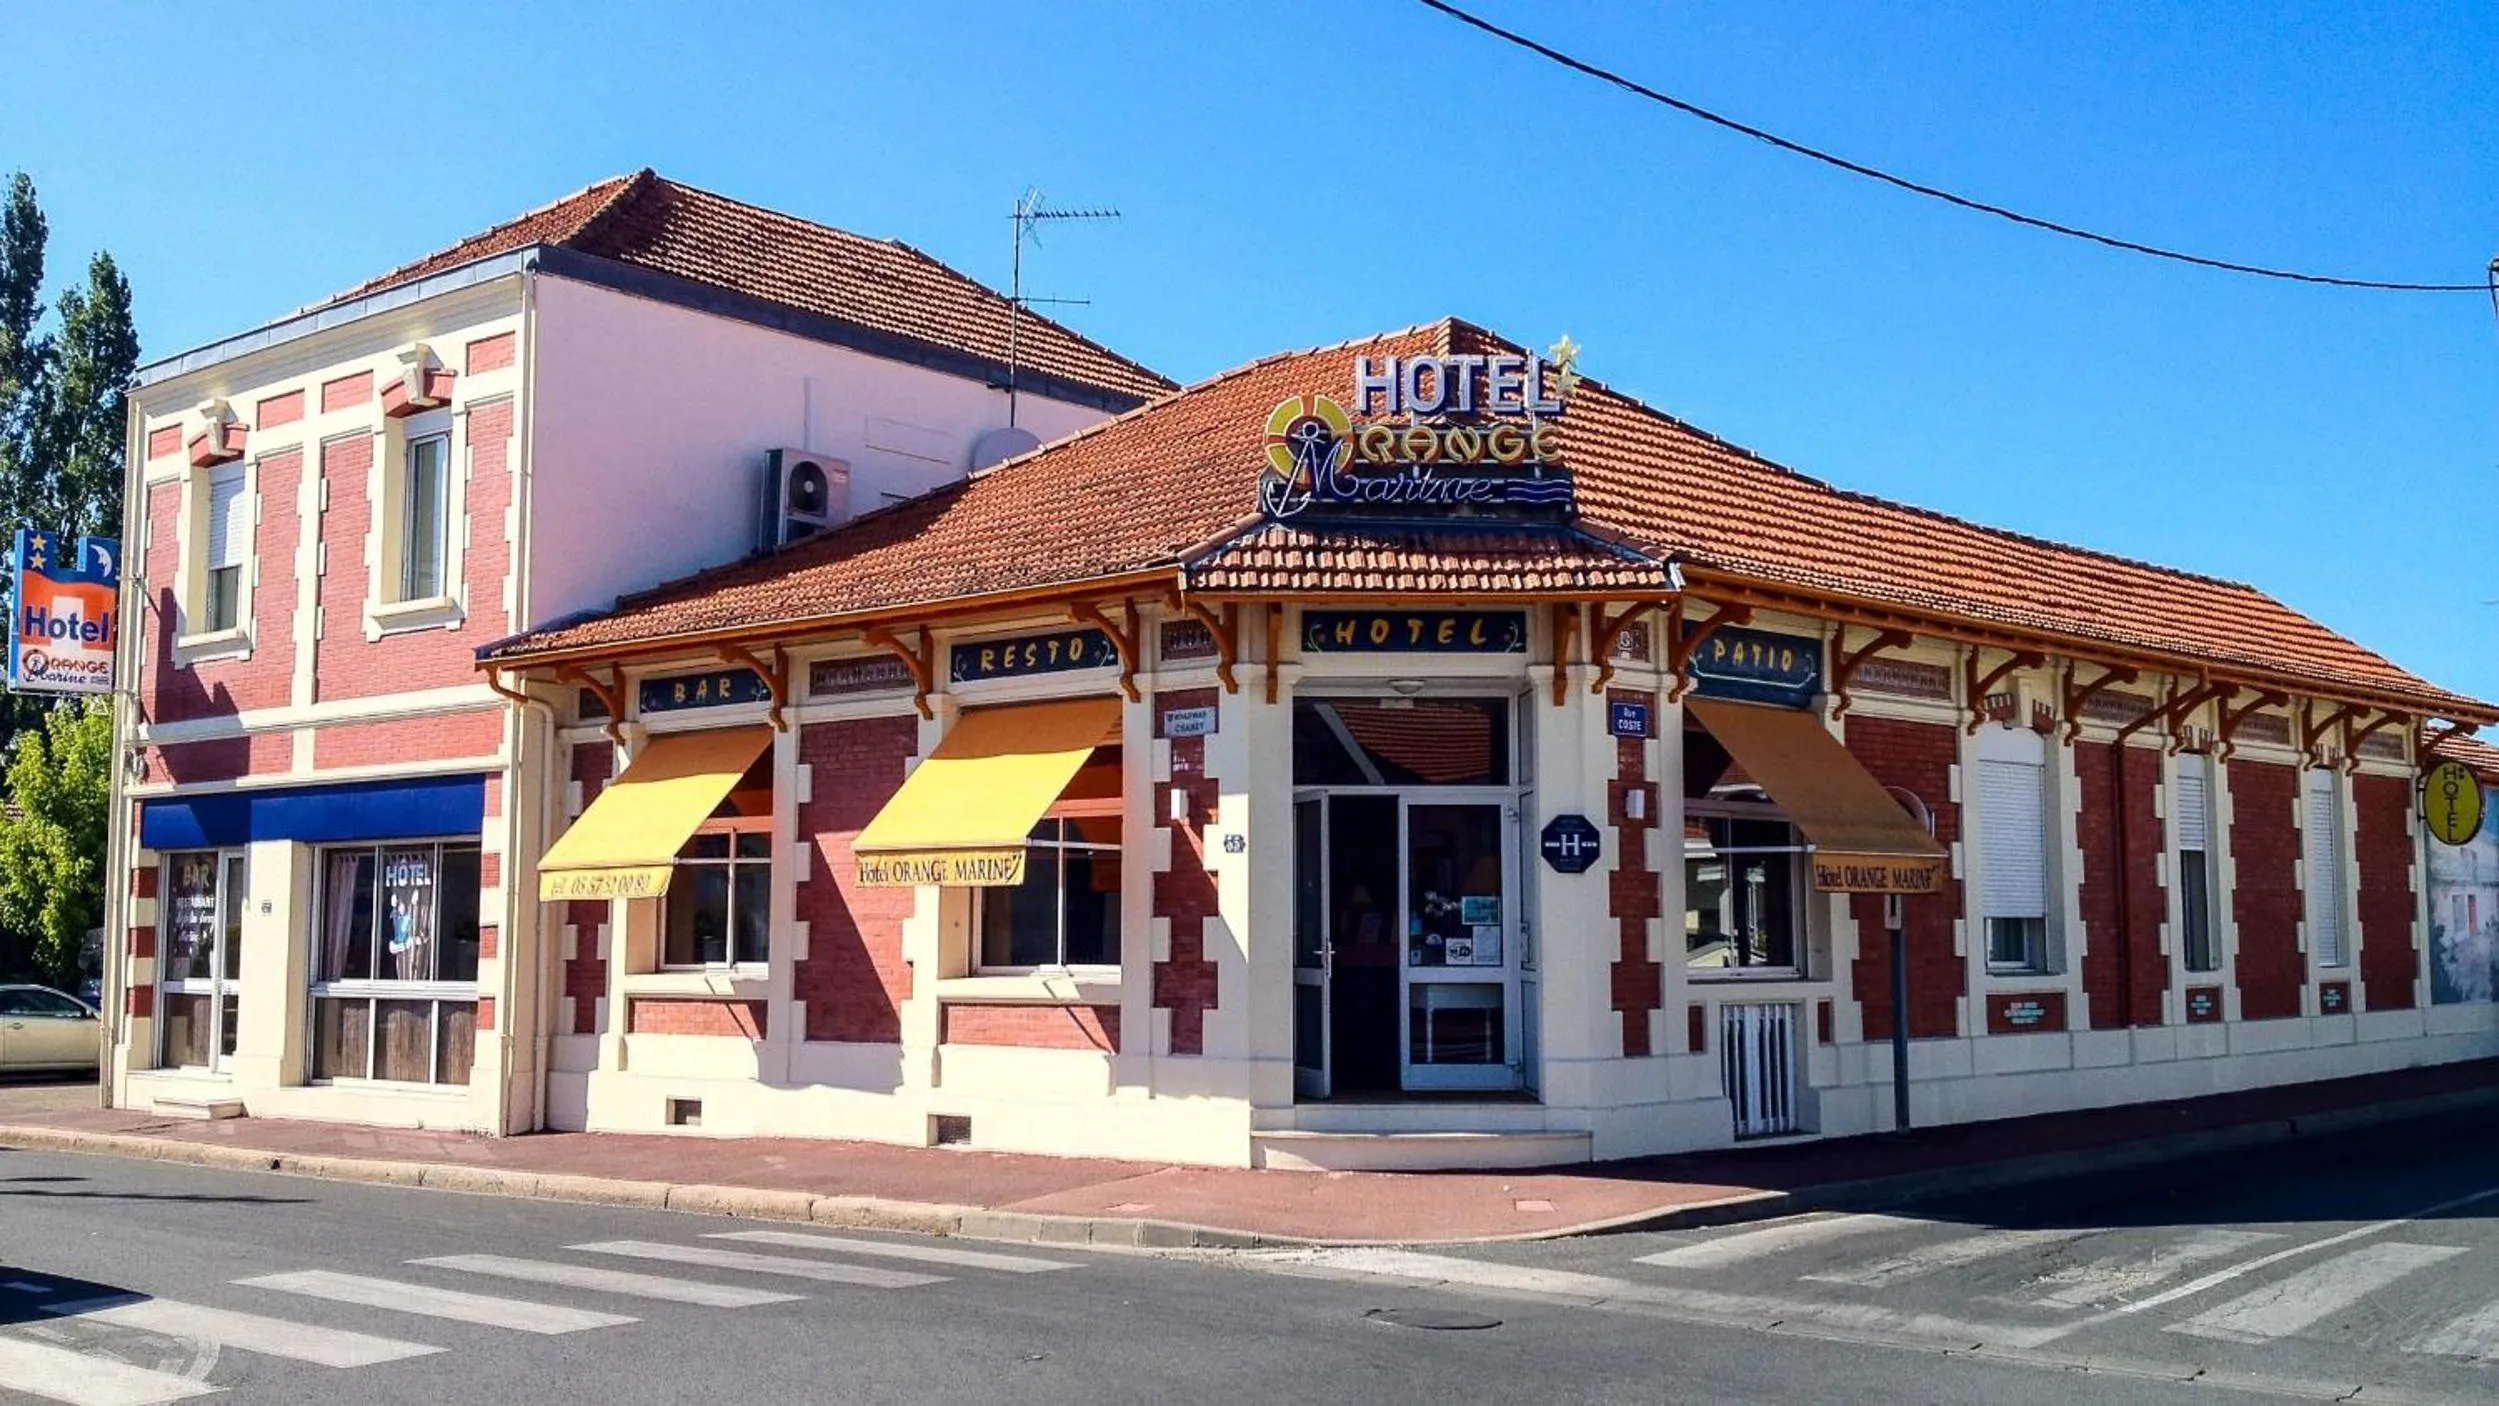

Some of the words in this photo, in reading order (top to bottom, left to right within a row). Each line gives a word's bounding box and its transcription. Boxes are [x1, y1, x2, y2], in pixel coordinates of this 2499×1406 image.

[1355, 352, 1563, 414] HOTEL
[24, 605, 110, 643] Hotel
[1334, 617, 1488, 646] HOTEL
[980, 636, 1083, 672] RESTO
[1713, 638, 1793, 673] PATIO
[673, 677, 731, 703] BAR
[1618, 719, 1642, 731] COSTE
[2443, 765, 2459, 842] HOTEL
[1561, 833, 1580, 856] H
[183, 864, 210, 887] BAR
[859, 857, 889, 883] Hotel
[893, 859, 949, 882] ORANGE
[1844, 865, 1887, 888] ORANGE
